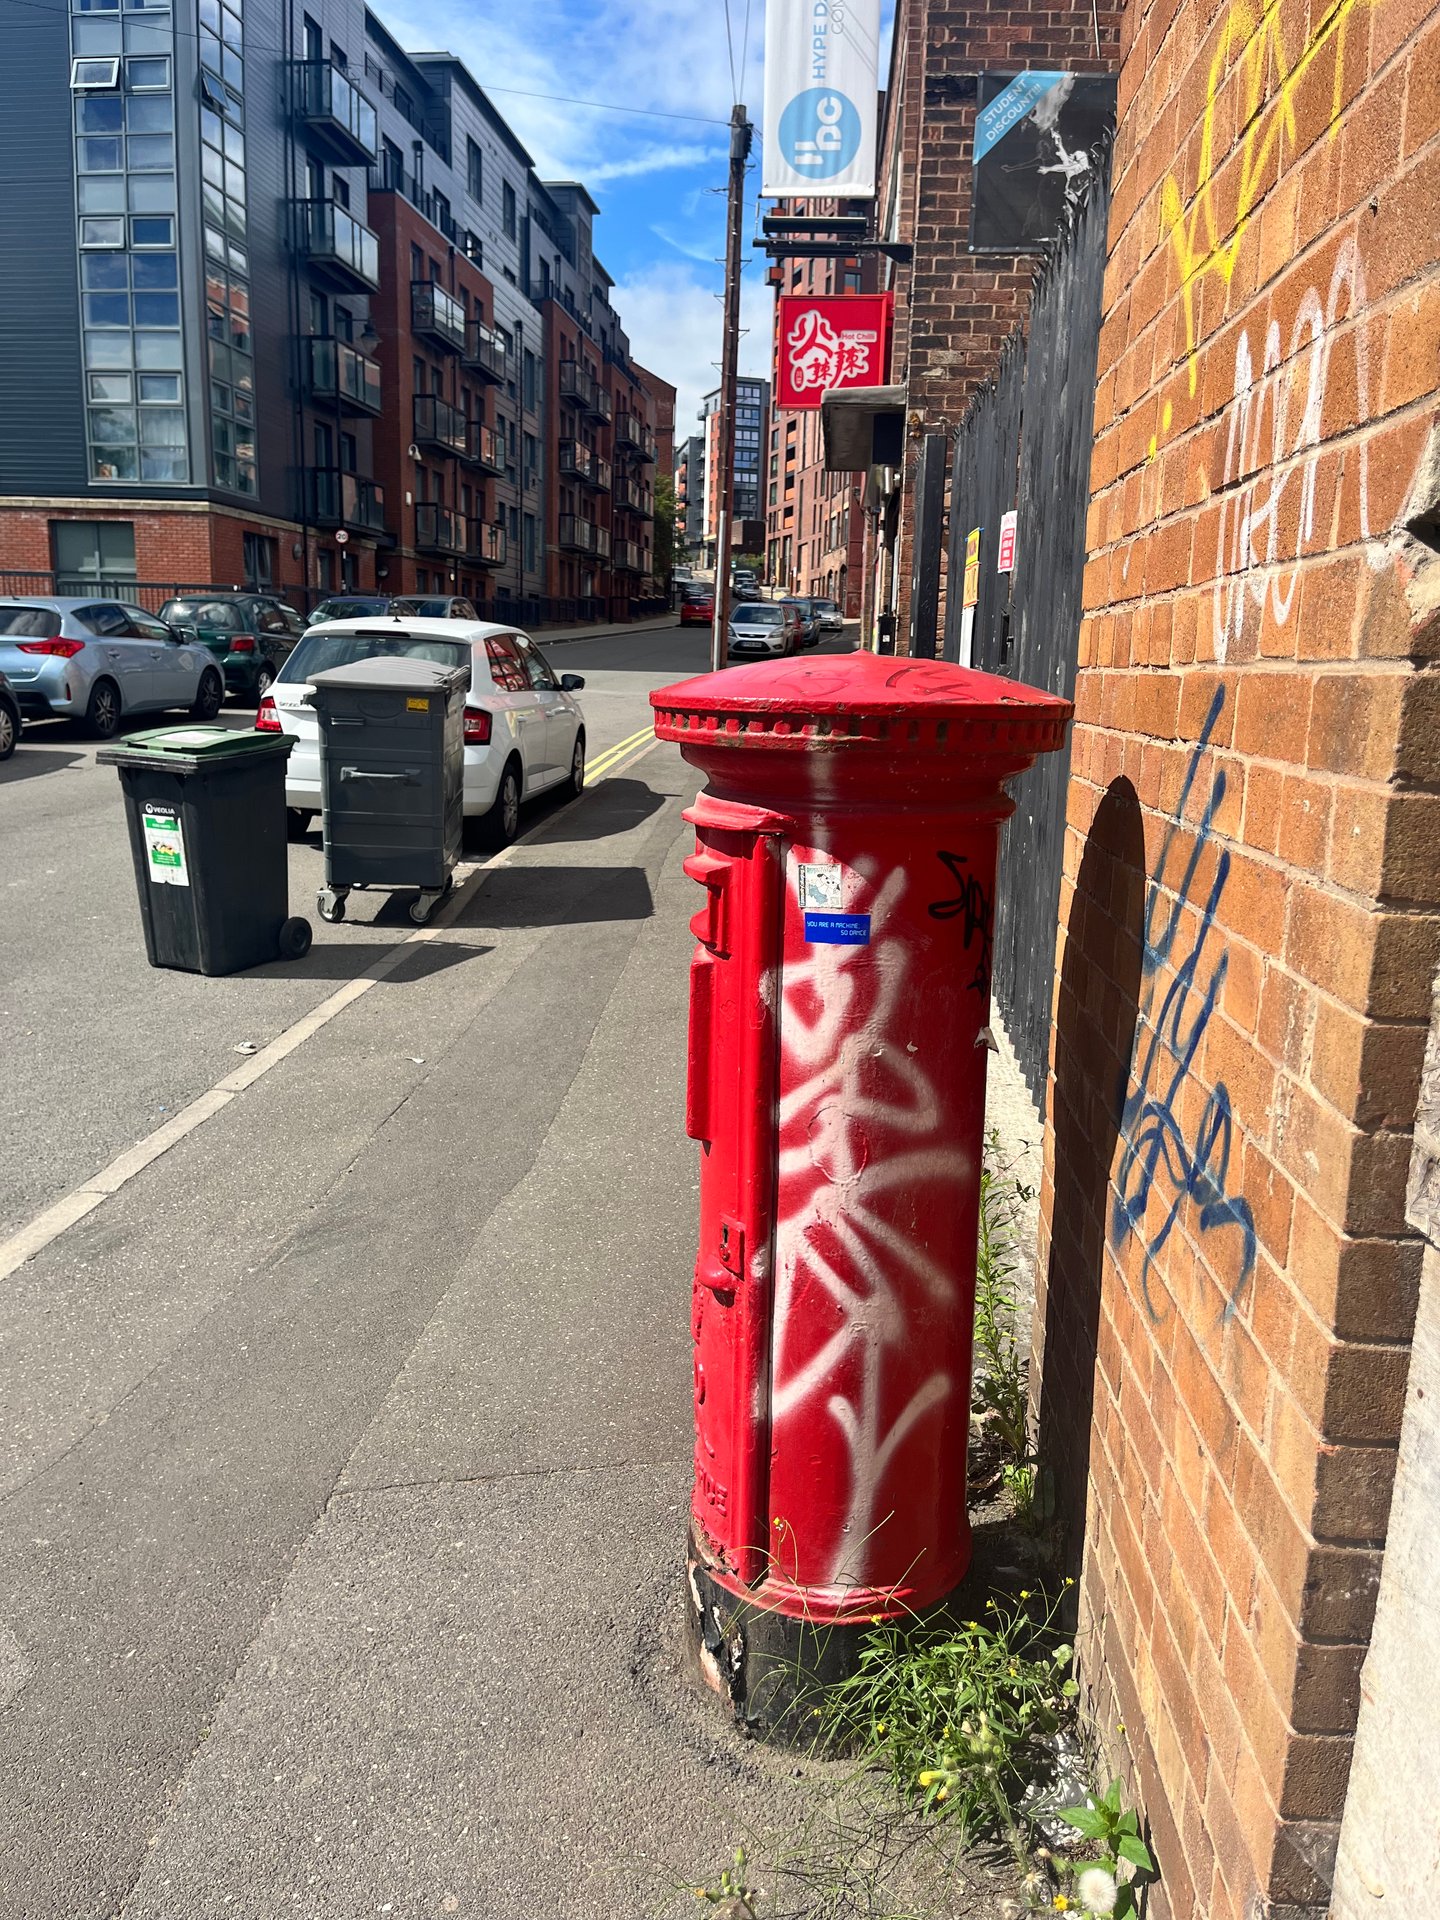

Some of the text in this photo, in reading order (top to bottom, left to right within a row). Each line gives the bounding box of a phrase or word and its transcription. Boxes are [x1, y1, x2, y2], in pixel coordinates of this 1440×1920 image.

[812, 0, 828, 79] HYPE D
[983, 79, 1027, 126] STUDENT
[985, 83, 1042, 142] DISCOUNT!!!
